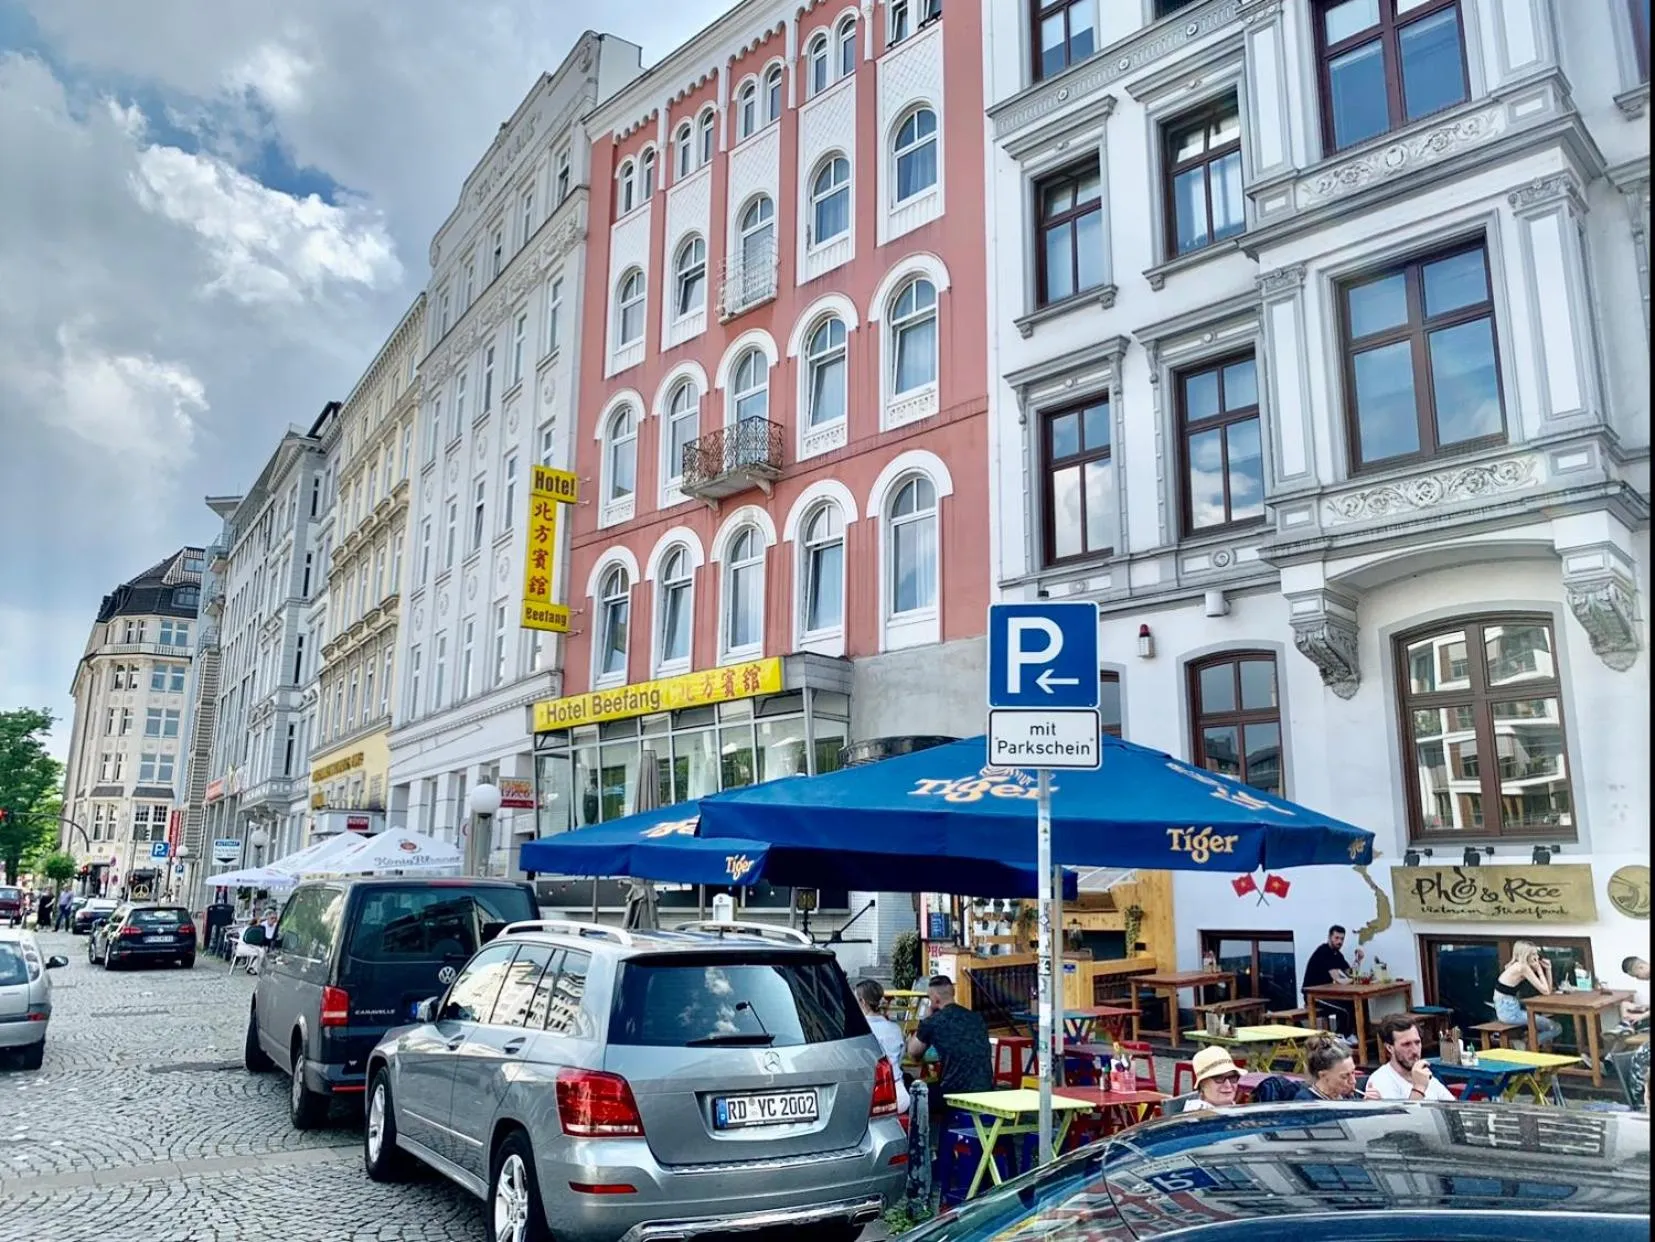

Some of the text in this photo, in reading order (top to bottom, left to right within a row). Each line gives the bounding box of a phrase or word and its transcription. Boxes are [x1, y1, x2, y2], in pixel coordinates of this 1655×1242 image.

[535, 470, 575, 496] Hotel
[525, 607, 567, 627] Beefang
[1007, 617, 1063, 693] P
[547, 688, 661, 725] Hotel Beefang
[1029, 722, 1057, 736] mit
[997, 740, 1091, 755] Parkschein
[907, 775, 1061, 803] Tiger
[154, 843, 165, 856] P
[1166, 826, 1239, 864] Tiger
[725, 854, 755, 881] Tiger
[1480, 887, 1499, 903] &
[1503, 878, 1571, 904] Rice
[354, 1008, 396, 1016] CARAVELLE
[727, 1095, 816, 1120] RD YC 2002
